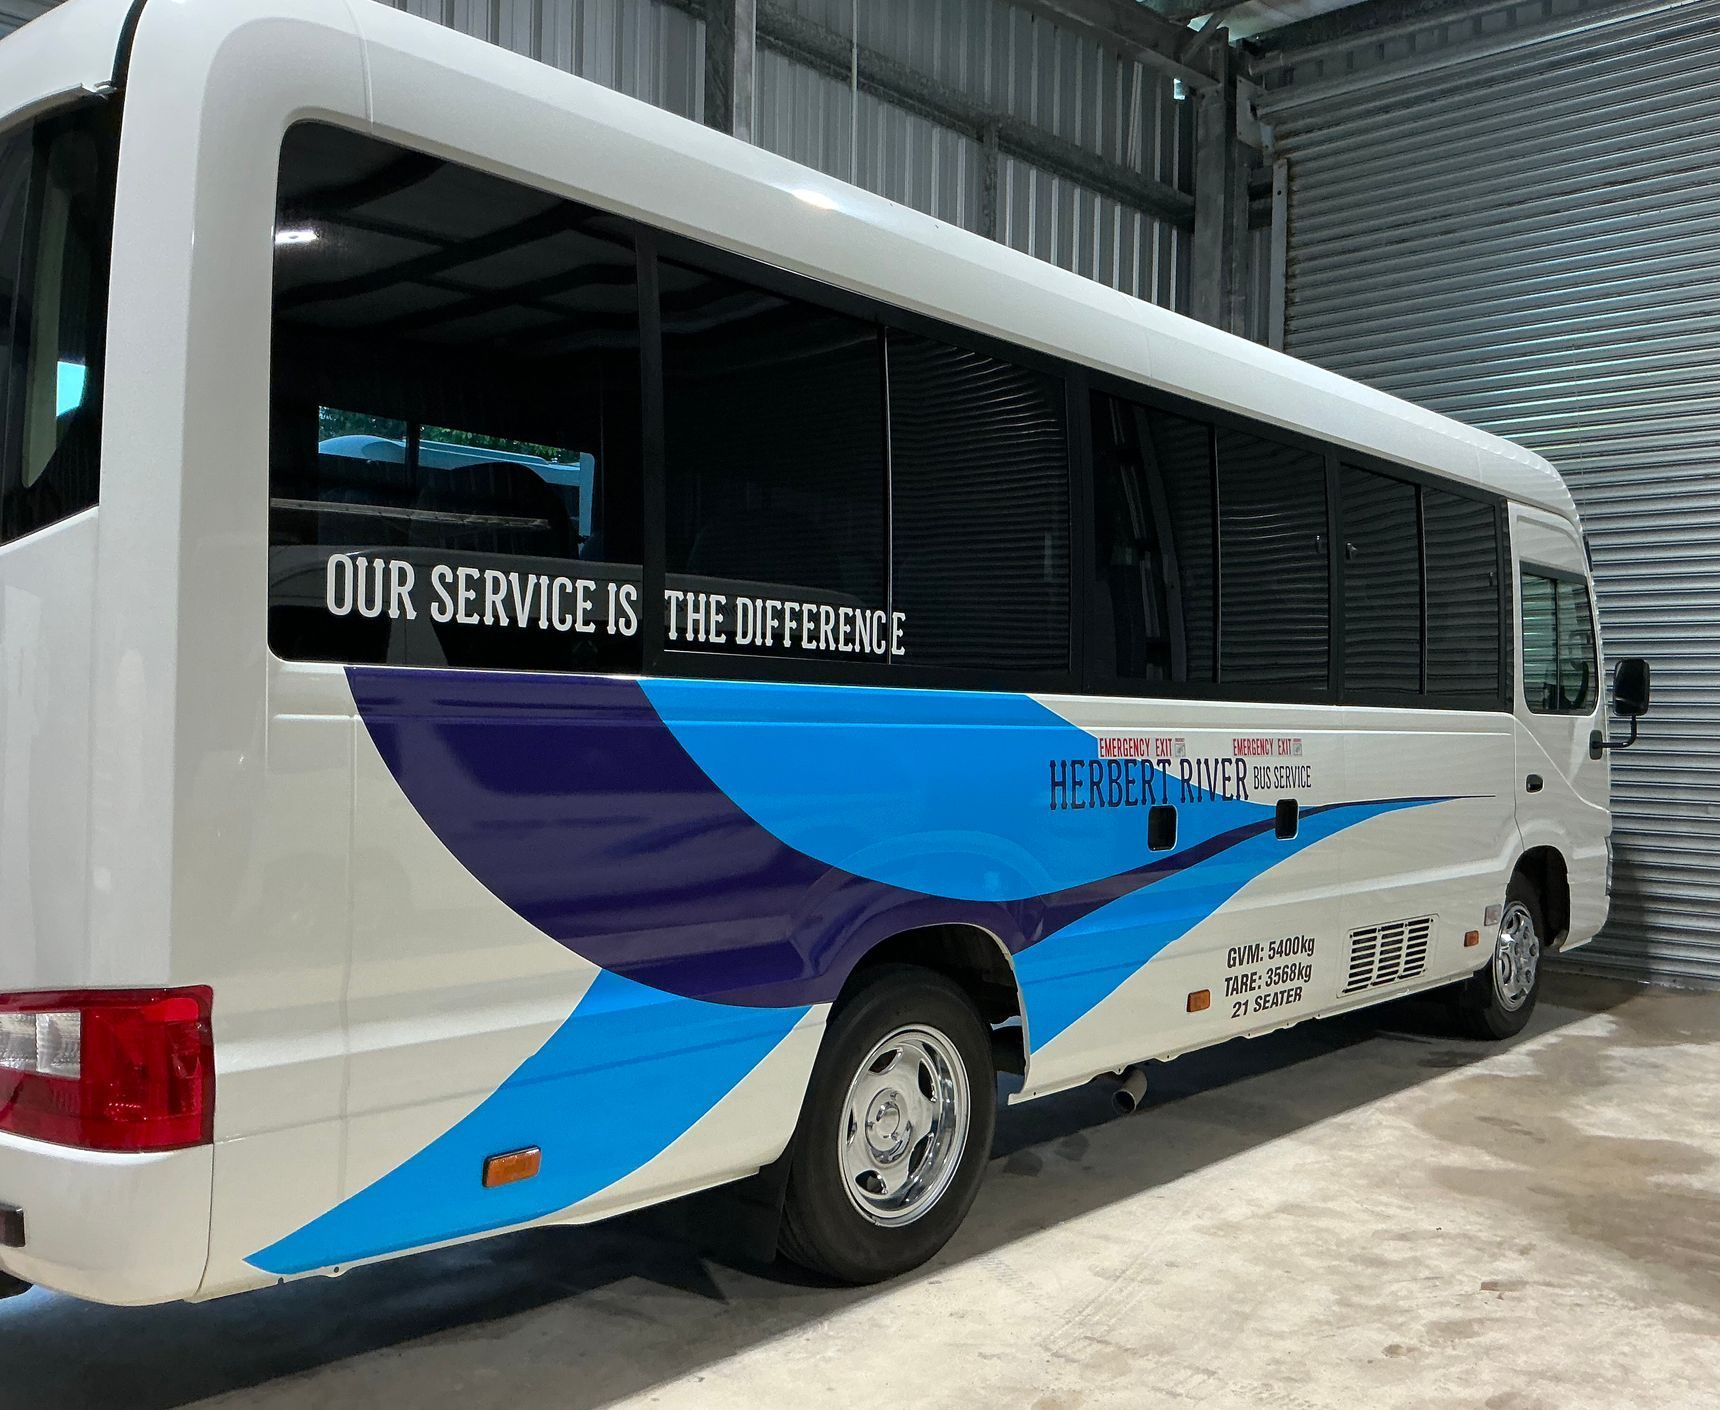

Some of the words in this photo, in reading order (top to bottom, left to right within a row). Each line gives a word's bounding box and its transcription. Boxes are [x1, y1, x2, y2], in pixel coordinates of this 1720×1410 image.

[326, 553, 417, 620] OUR
[430, 564, 596, 633] SERVICE
[607, 582, 638, 637] IS
[664, 589, 727, 643] THE
[735, 596, 906, 656] DIFFERENCE
[1099, 738, 1150, 757] EMERGENCY
[1155, 738, 1172, 757] EXIT
[1233, 738, 1274, 756] EMERGENCY
[1278, 738, 1291, 755] EXIT
[1050, 758, 1172, 810] HERBERT
[1179, 757, 1249, 804] RIVER
[1253, 766, 1271, 790] BUS
[1273, 765, 1312, 789] SERVICE
[1226, 943, 1264, 968] GVM:
[1268, 935, 1315, 960] 5400kg
[1224, 971, 1262, 997] TARE:
[1265, 961, 1313, 987] 3568kg
[1231, 999, 1249, 1019] 21
[1253, 986, 1303, 1013] SEATER
